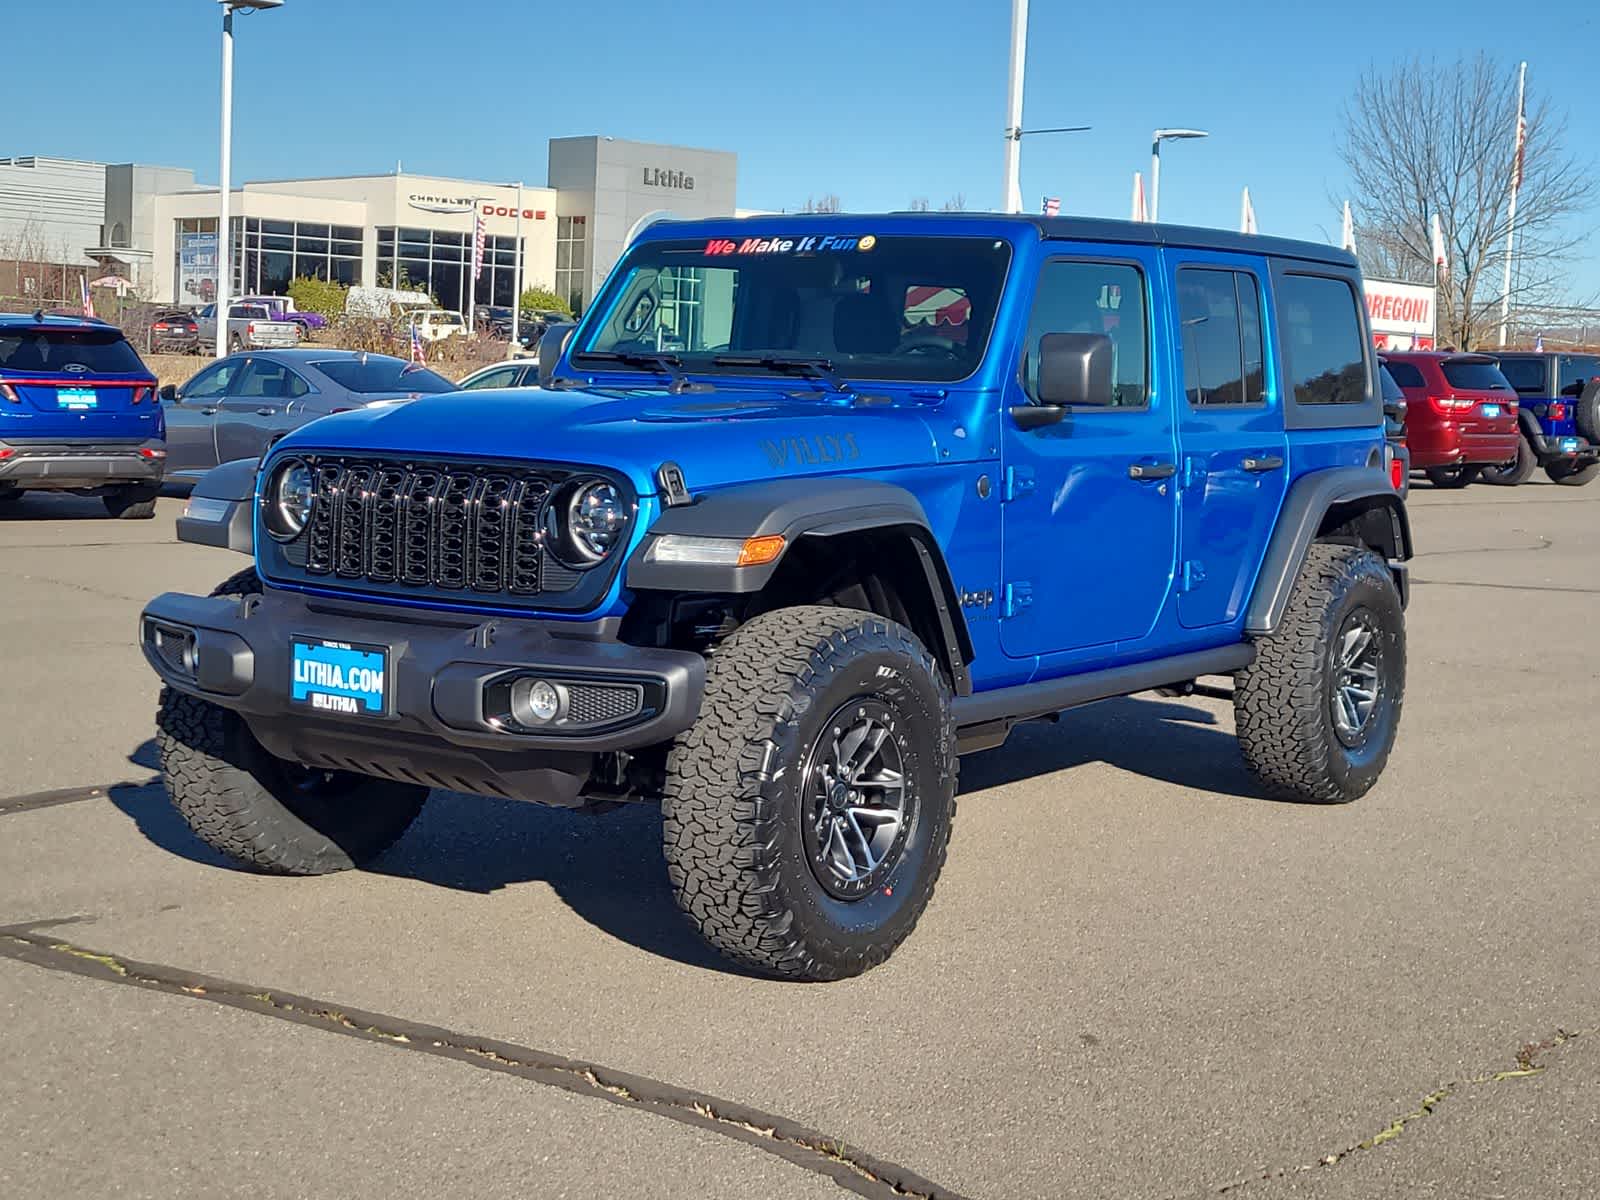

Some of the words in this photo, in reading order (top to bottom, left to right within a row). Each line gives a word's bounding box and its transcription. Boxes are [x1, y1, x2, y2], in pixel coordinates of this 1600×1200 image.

[643, 167, 694, 190] Lithia
[409, 194, 472, 205] CHRYSLER
[482, 205, 546, 220] DODGE
[704, 239, 736, 255] We
[738, 237, 793, 253] Make
[796, 236, 816, 251] It
[817, 235, 858, 250] Fun
[760, 432, 859, 468] WILLYS
[959, 586, 993, 610] Jeep
[294, 658, 384, 694] LITHIA.COM
